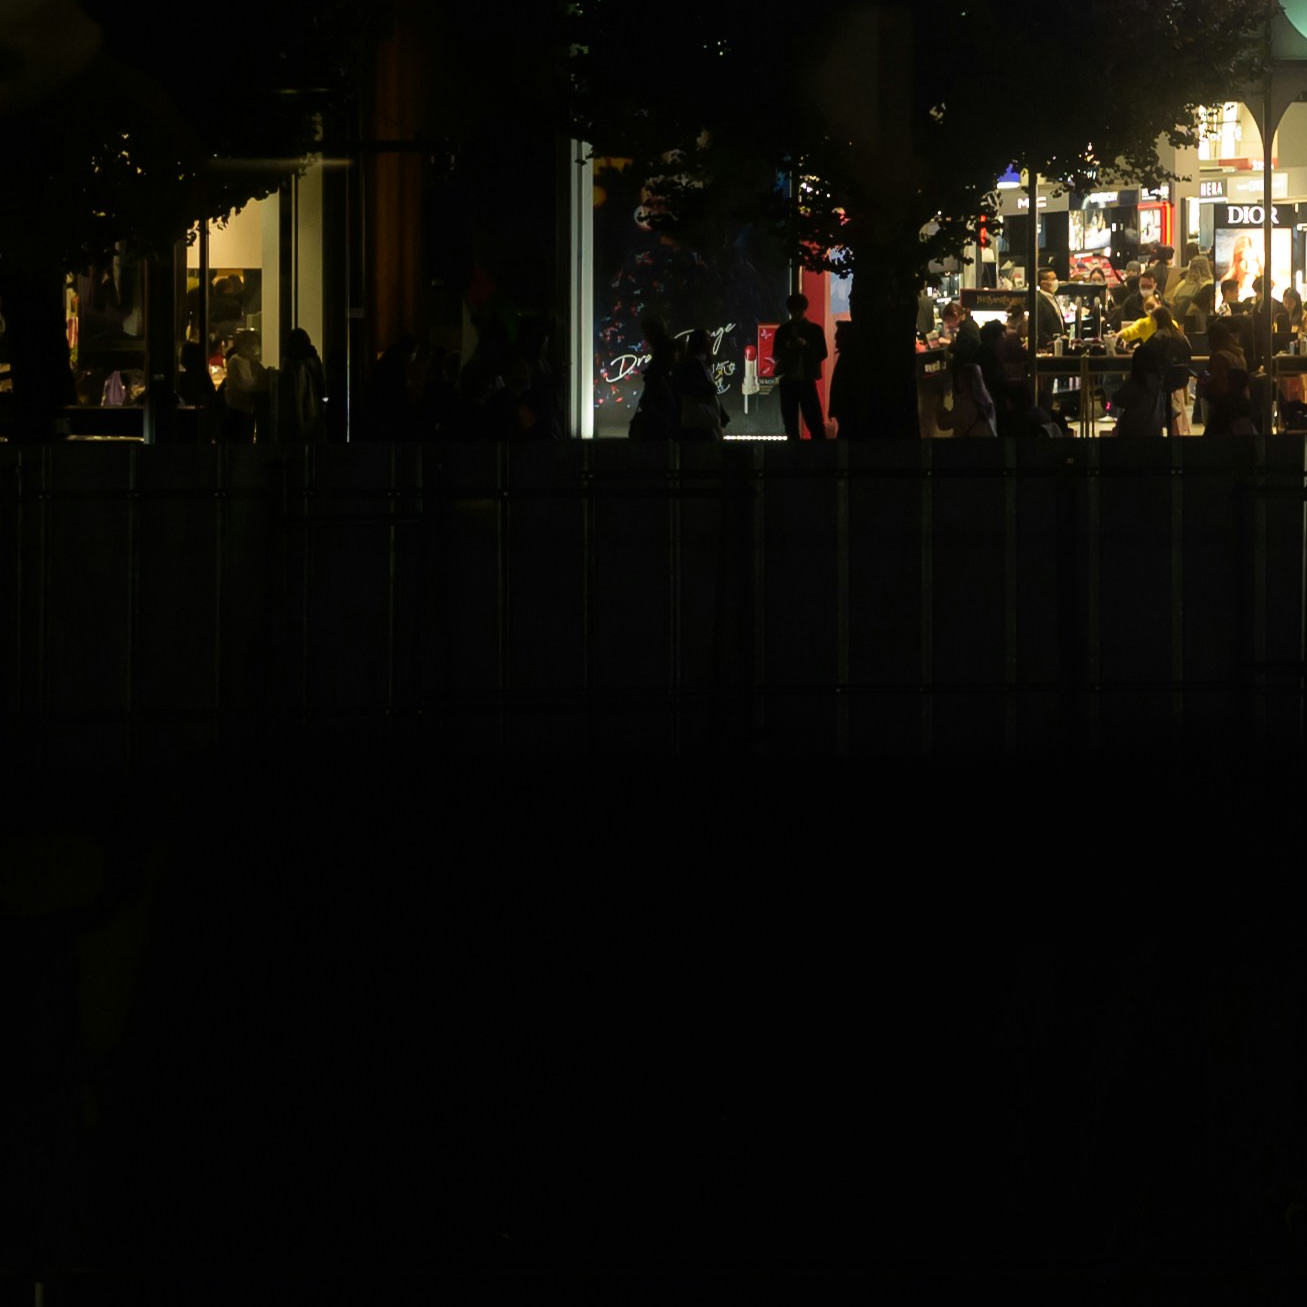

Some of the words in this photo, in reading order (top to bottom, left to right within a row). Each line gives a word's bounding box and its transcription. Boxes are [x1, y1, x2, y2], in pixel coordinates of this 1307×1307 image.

[1200, 182, 1223, 196] HERA
[1017, 196, 1047, 209] MC
[1227, 206, 1279, 224] DIOR
[605, 354, 653, 383] Dra
